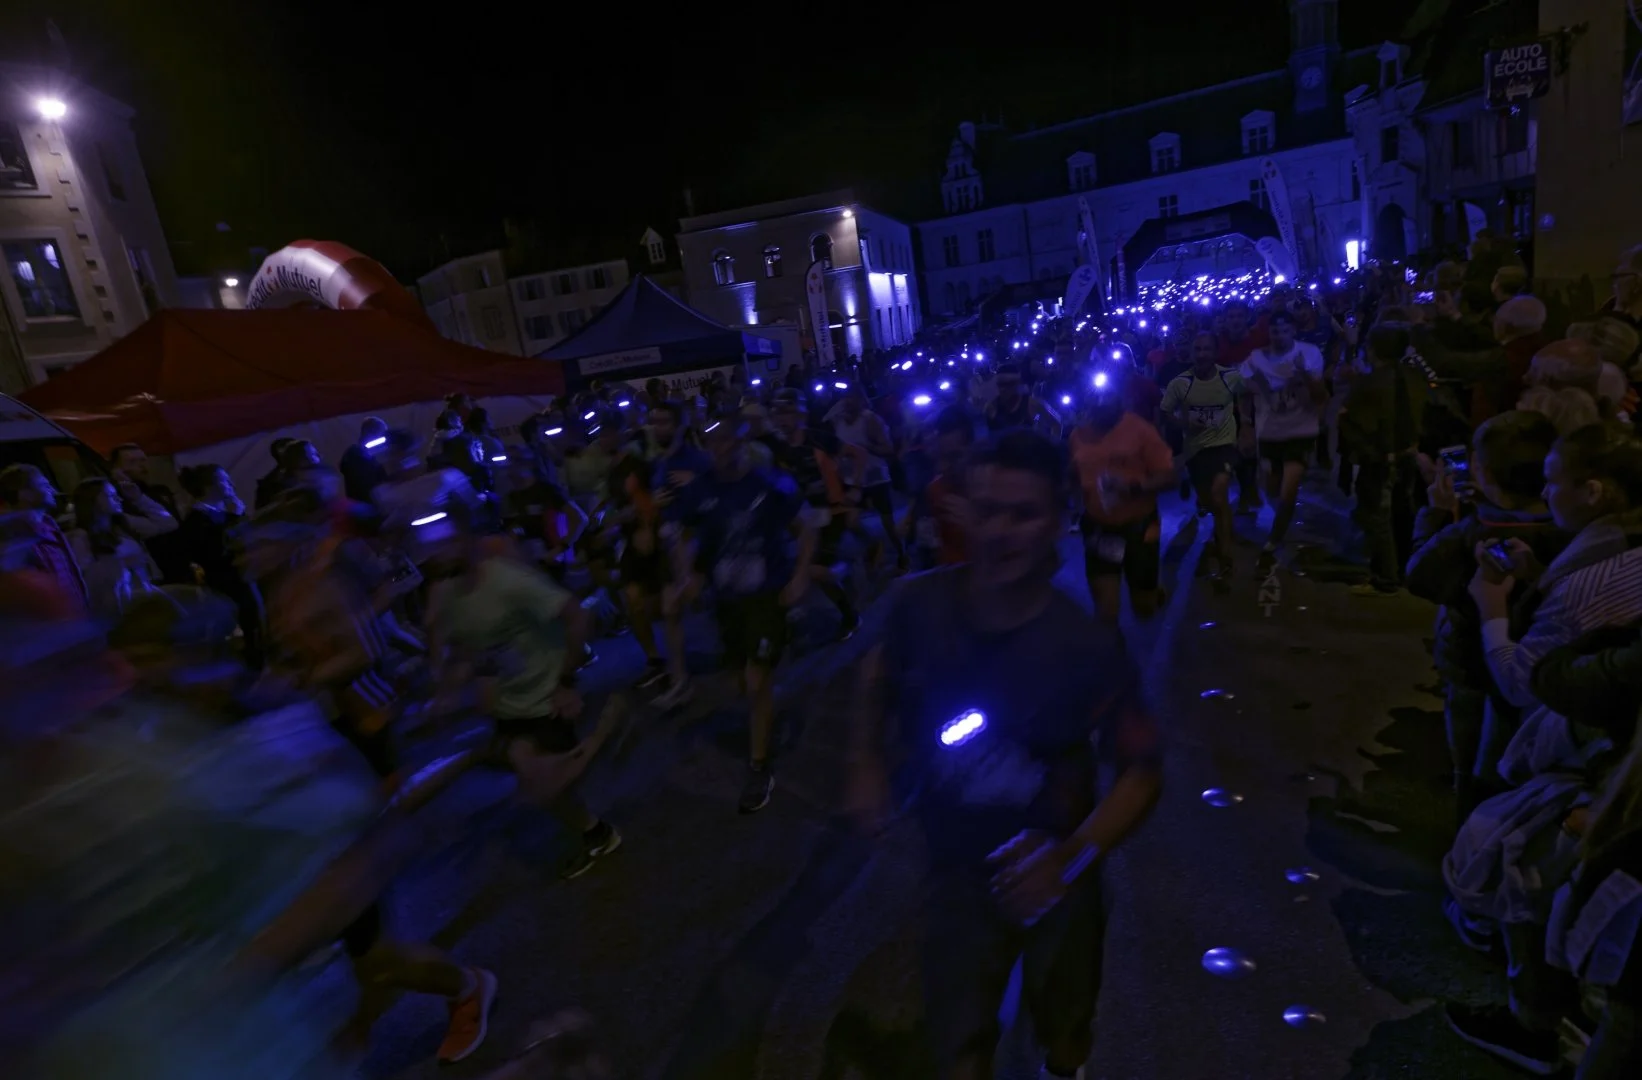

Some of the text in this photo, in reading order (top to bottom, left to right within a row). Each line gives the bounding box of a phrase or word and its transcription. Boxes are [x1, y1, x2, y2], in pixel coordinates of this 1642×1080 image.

[1500, 43, 1543, 62] AUTO
[1494, 56, 1548, 78] ECOLE
[277, 264, 325, 300] Mutuel
